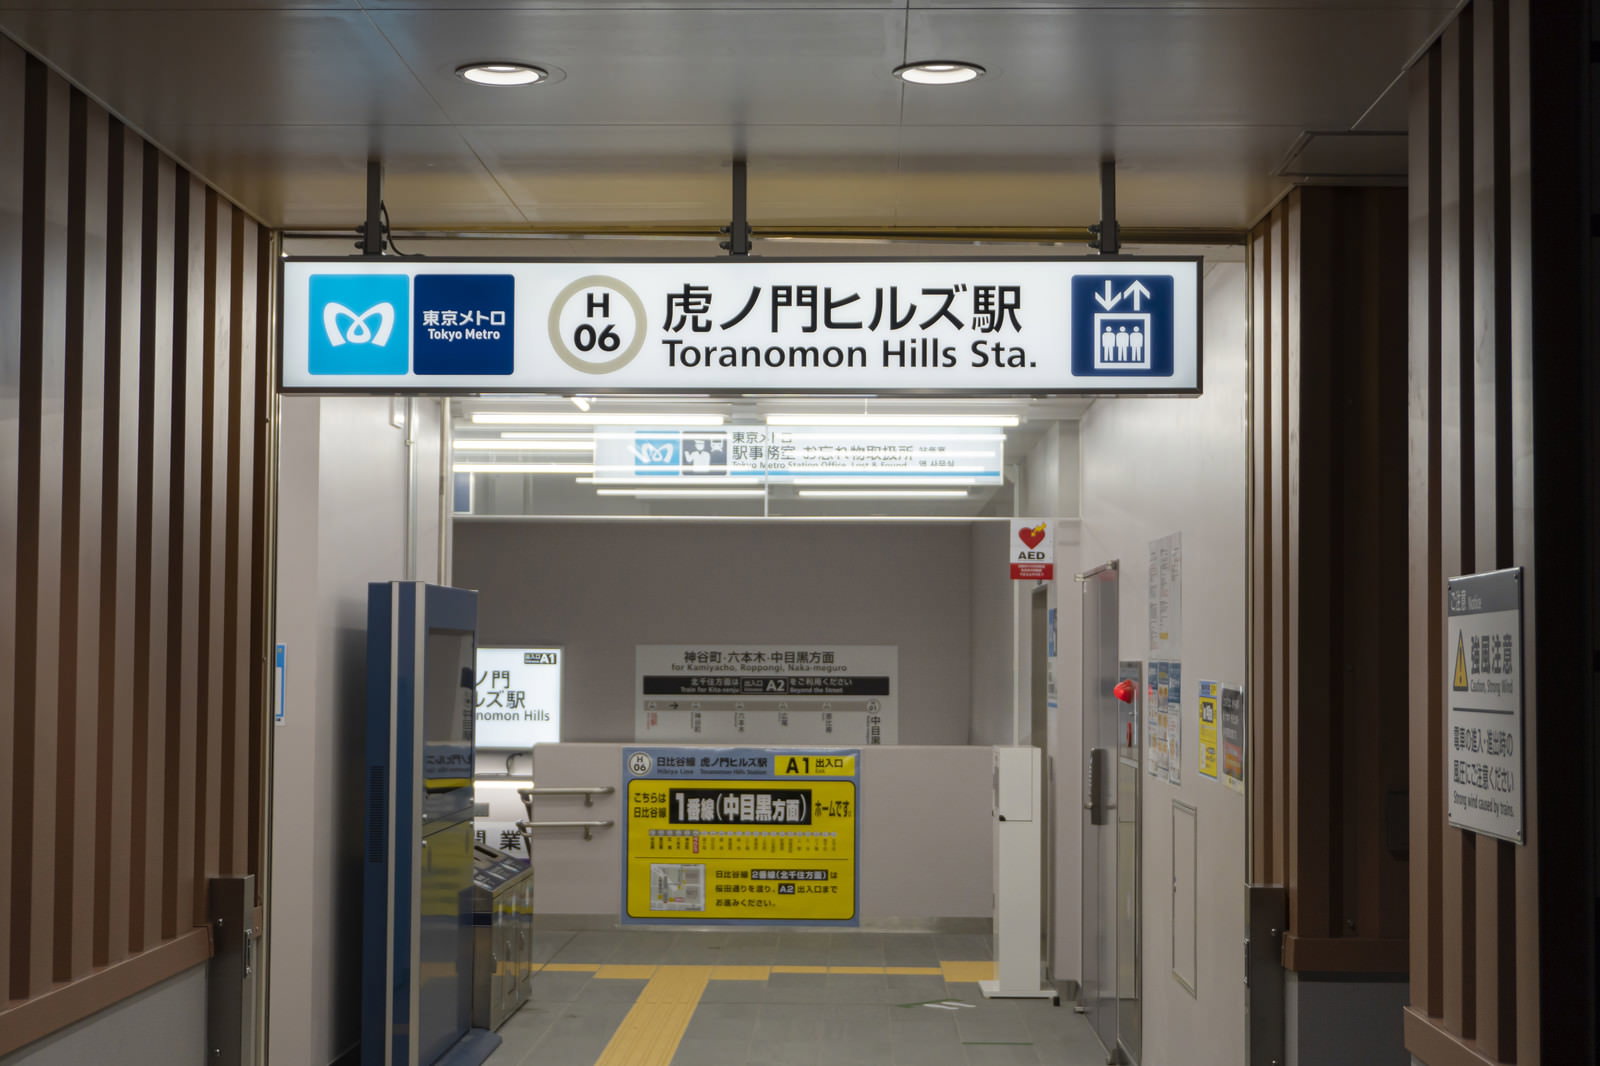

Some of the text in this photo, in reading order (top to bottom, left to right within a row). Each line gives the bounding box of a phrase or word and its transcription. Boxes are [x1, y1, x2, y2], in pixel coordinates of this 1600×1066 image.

[587, 292, 609, 318] H
[662, 283, 1022, 334] 虎ノ門ヒルズ駅
[423, 310, 505, 326] 東京メトロ
[428, 328, 501, 341] Tokyo Metro
[573, 323, 621, 352] 06
[662, 338, 1037, 368] Toranomon Hills Sta.
[732, 446, 796, 461] 駅事務室
[1018, 551, 1045, 560] AED
[1450, 590, 1467, 611] ご注意
[540, 653, 555, 664] A1
[1471, 633, 1513, 674] 強風注意
[672, 663, 684, 671] for
[788, 663, 847, 673] Naka-meguro
[766, 680, 785, 692] A2
[524, 709, 550, 721] Hills
[633, 763, 647, 772] 06
[786, 757, 809, 774] A1
[815, 759, 843, 768] 出入口
[634, 792, 666, 804] こちらは
[633, 807, 667, 818] 日比谷線
[814, 800, 851, 817] ホームです。
[779, 885, 794, 893] A2
